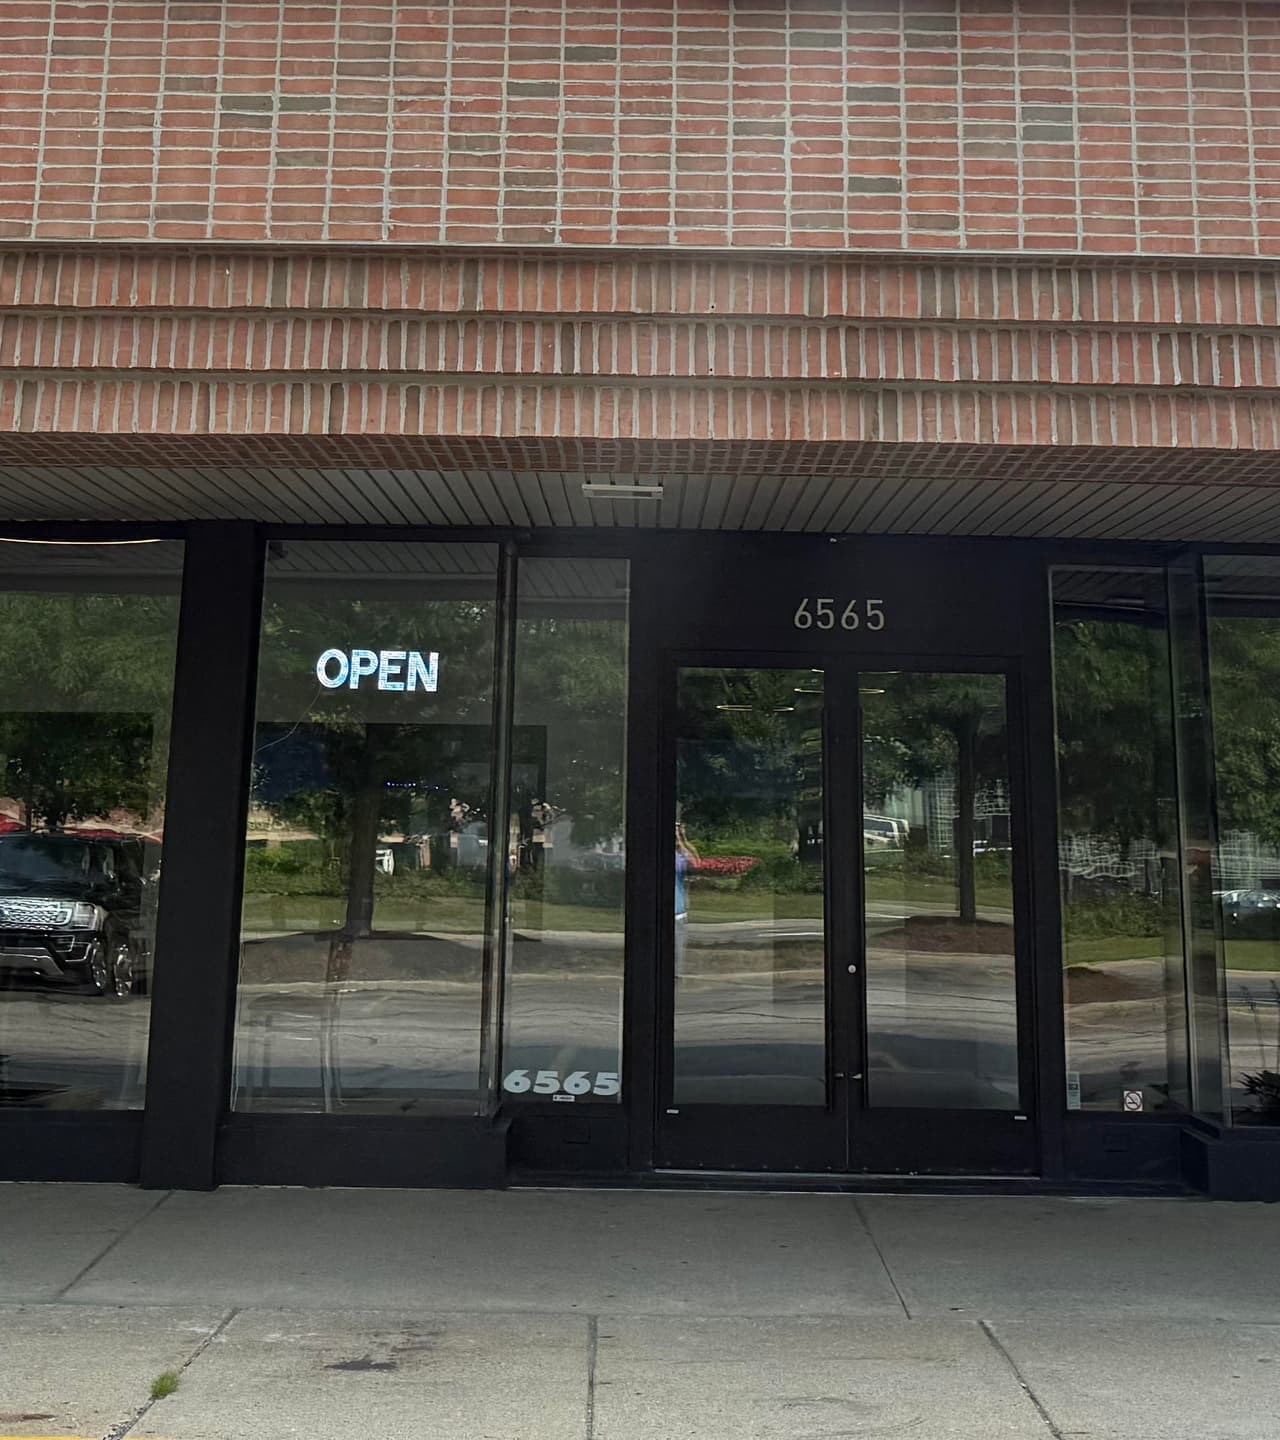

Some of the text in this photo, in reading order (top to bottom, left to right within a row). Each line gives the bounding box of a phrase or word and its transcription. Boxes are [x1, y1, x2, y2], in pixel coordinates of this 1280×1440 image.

[793, 598, 886, 631] 6565
[316, 648, 440, 693] OPEN
[503, 1069, 620, 1096] 6565
